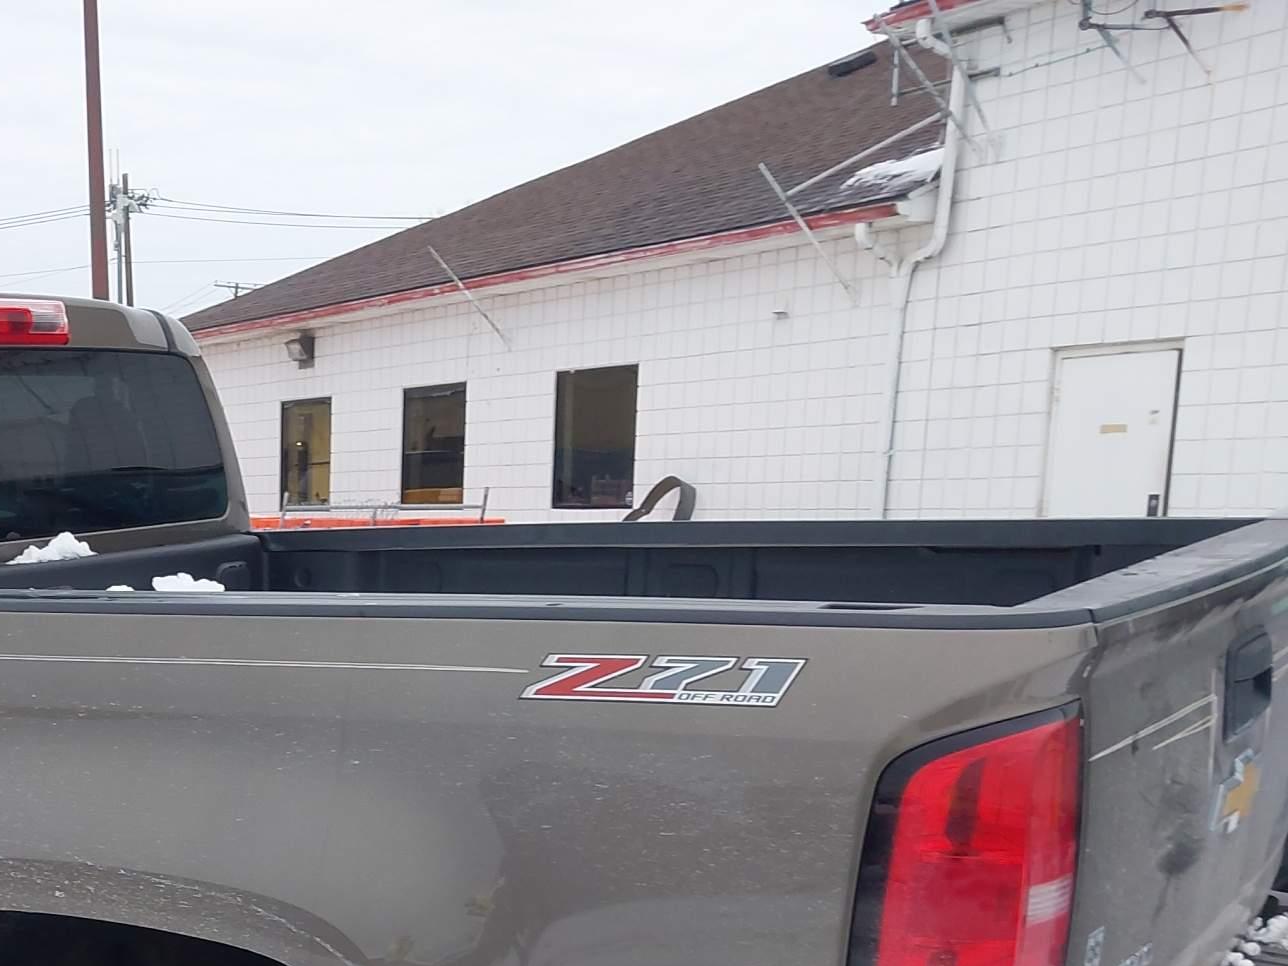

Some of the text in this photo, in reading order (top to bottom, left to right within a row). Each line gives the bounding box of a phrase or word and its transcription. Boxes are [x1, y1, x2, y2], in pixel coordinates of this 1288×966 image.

[519, 653, 808, 702] Z71
[678, 692, 776, 704] OFF ROAD
